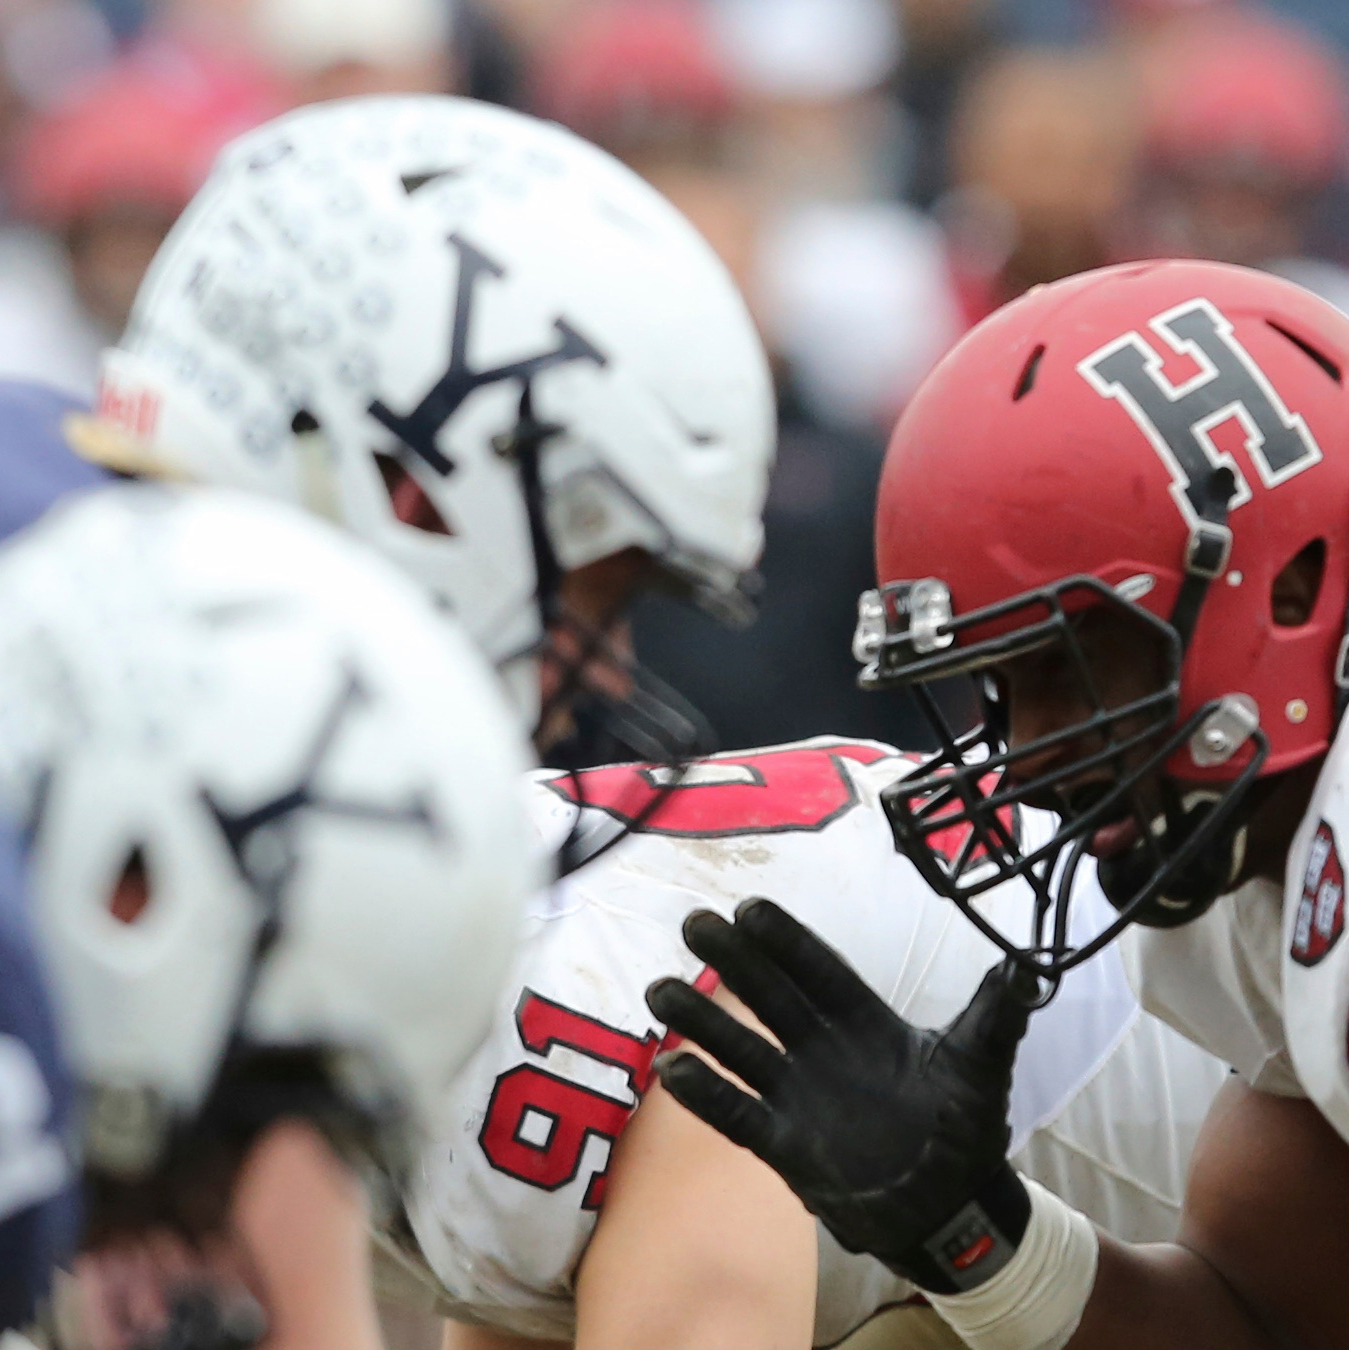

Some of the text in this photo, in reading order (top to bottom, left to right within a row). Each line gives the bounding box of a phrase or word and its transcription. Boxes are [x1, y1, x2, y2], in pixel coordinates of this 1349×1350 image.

[366, 232, 608, 476] Y
[1077, 297, 1323, 528] H
[194, 655, 458, 888] Y
[478, 986, 662, 1210] 91
